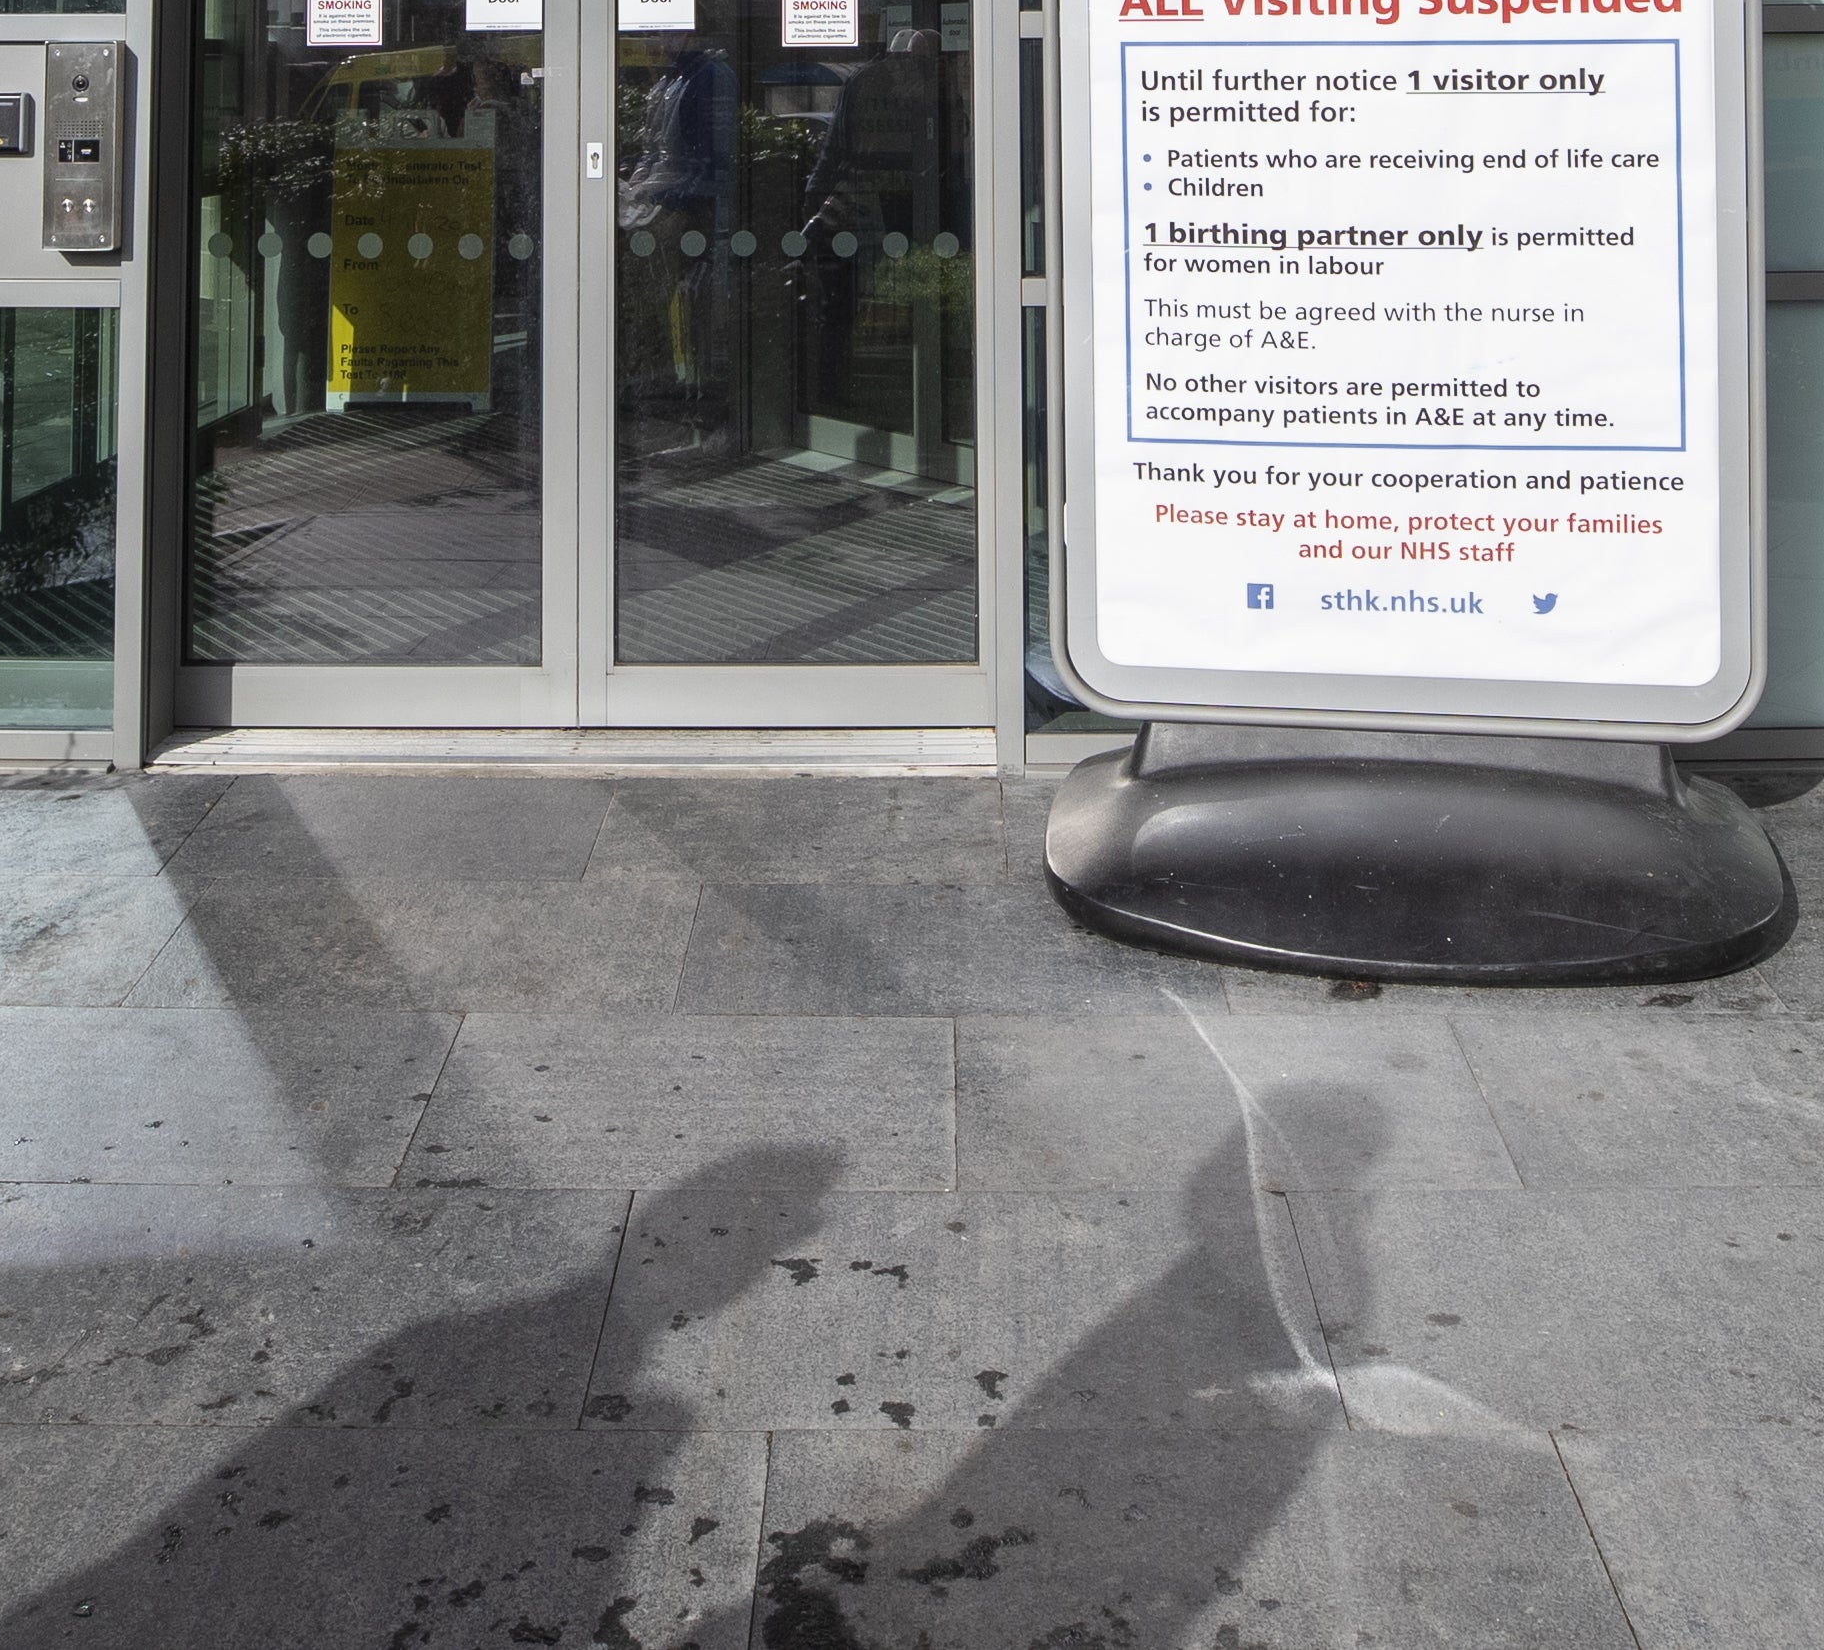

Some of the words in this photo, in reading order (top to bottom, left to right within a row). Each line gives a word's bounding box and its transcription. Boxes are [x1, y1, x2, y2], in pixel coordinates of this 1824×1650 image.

[317, 0, 372, 10] SMOKING
[792, 0, 848, 10] SMOKING
[1142, 69, 1202, 91] Until
[1212, 69, 1306, 91] further
[1317, 69, 1397, 91] notice
[1408, 70, 1419, 92] 1
[1433, 69, 1529, 92] visitor
[1540, 68, 1604, 95] only
[1142, 100, 1160, 122] is
[1170, 100, 1299, 128] permitted
[1310, 100, 1355, 123] for:
[1168, 149, 1258, 168] Patients
[1266, 149, 1317, 169] who
[1326, 154, 1361, 169] are
[1370, 149, 1473, 174] receiving
[1483, 149, 1525, 169] end
[1535, 148, 1558, 169] of
[1568, 148, 1603, 168] life
[1612, 154, 1659, 168] care
[1169, 177, 1263, 197] Children
[344, 214, 375, 226] Date
[1145, 223, 1156, 245] 1
[1170, 221, 1286, 249] birthing
[1298, 226, 1408, 250] partner
[1419, 223, 1483, 250] only
[1492, 227, 1508, 246] is
[1518, 226, 1633, 251] permitted
[343, 259, 379, 271] From
[1144, 252, 1177, 272] for
[1185, 259, 1270, 274] women
[1280, 255, 1299, 275] in
[1309, 255, 1384, 276] labour
[342, 303, 359, 316] To
[1144, 298, 1188, 318] This
[1197, 302, 1250, 320] must
[1260, 300, 1286, 320] be
[1296, 301, 1375, 326] agreed
[1384, 302, 1435, 321] with
[1444, 301, 1482, 321] the
[1492, 307, 1554, 322] nurse
[1565, 303, 1583, 322] in
[1146, 326, 1220, 352] charge
[1230, 328, 1252, 348] of
[1261, 330, 1315, 350] A&E.
[1147, 373, 1176, 392] No
[1185, 373, 1246, 393] other
[1255, 375, 1337, 396] visitors
[1347, 382, 1382, 396] are
[1392, 377, 1507, 401] permitted
[1516, 381, 1540, 398] to
[1147, 405, 1274, 428] accompany
[1284, 406, 1377, 428] patients
[1387, 406, 1406, 425] in
[1416, 407, 1464, 426] A&E
[1473, 410, 1496, 427] at
[1504, 413, 1546, 432] any
[1555, 408, 1613, 427] time.
[1133, 461, 1204, 483] Thank
[1213, 469, 1256, 489] you
[1265, 465, 1300, 486] for
[1308, 472, 1363, 492] your
[1372, 469, 1516, 493] cooperation
[1526, 470, 1570, 490] and
[1581, 470, 1683, 495] patience
[1156, 503, 1228, 525] Please
[1237, 509, 1284, 532] stay
[1294, 512, 1316, 529] at
[1326, 509, 1398, 533] home,
[1409, 513, 1495, 535] protect
[1503, 517, 1558, 537] your
[1567, 513, 1662, 535] families
[1299, 539, 1342, 559] and
[1352, 545, 1392, 559] our
[1402, 541, 1450, 560] NHS
[1460, 542, 1514, 562] staff
[1321, 588, 1483, 615] sthk.nhs.uk
